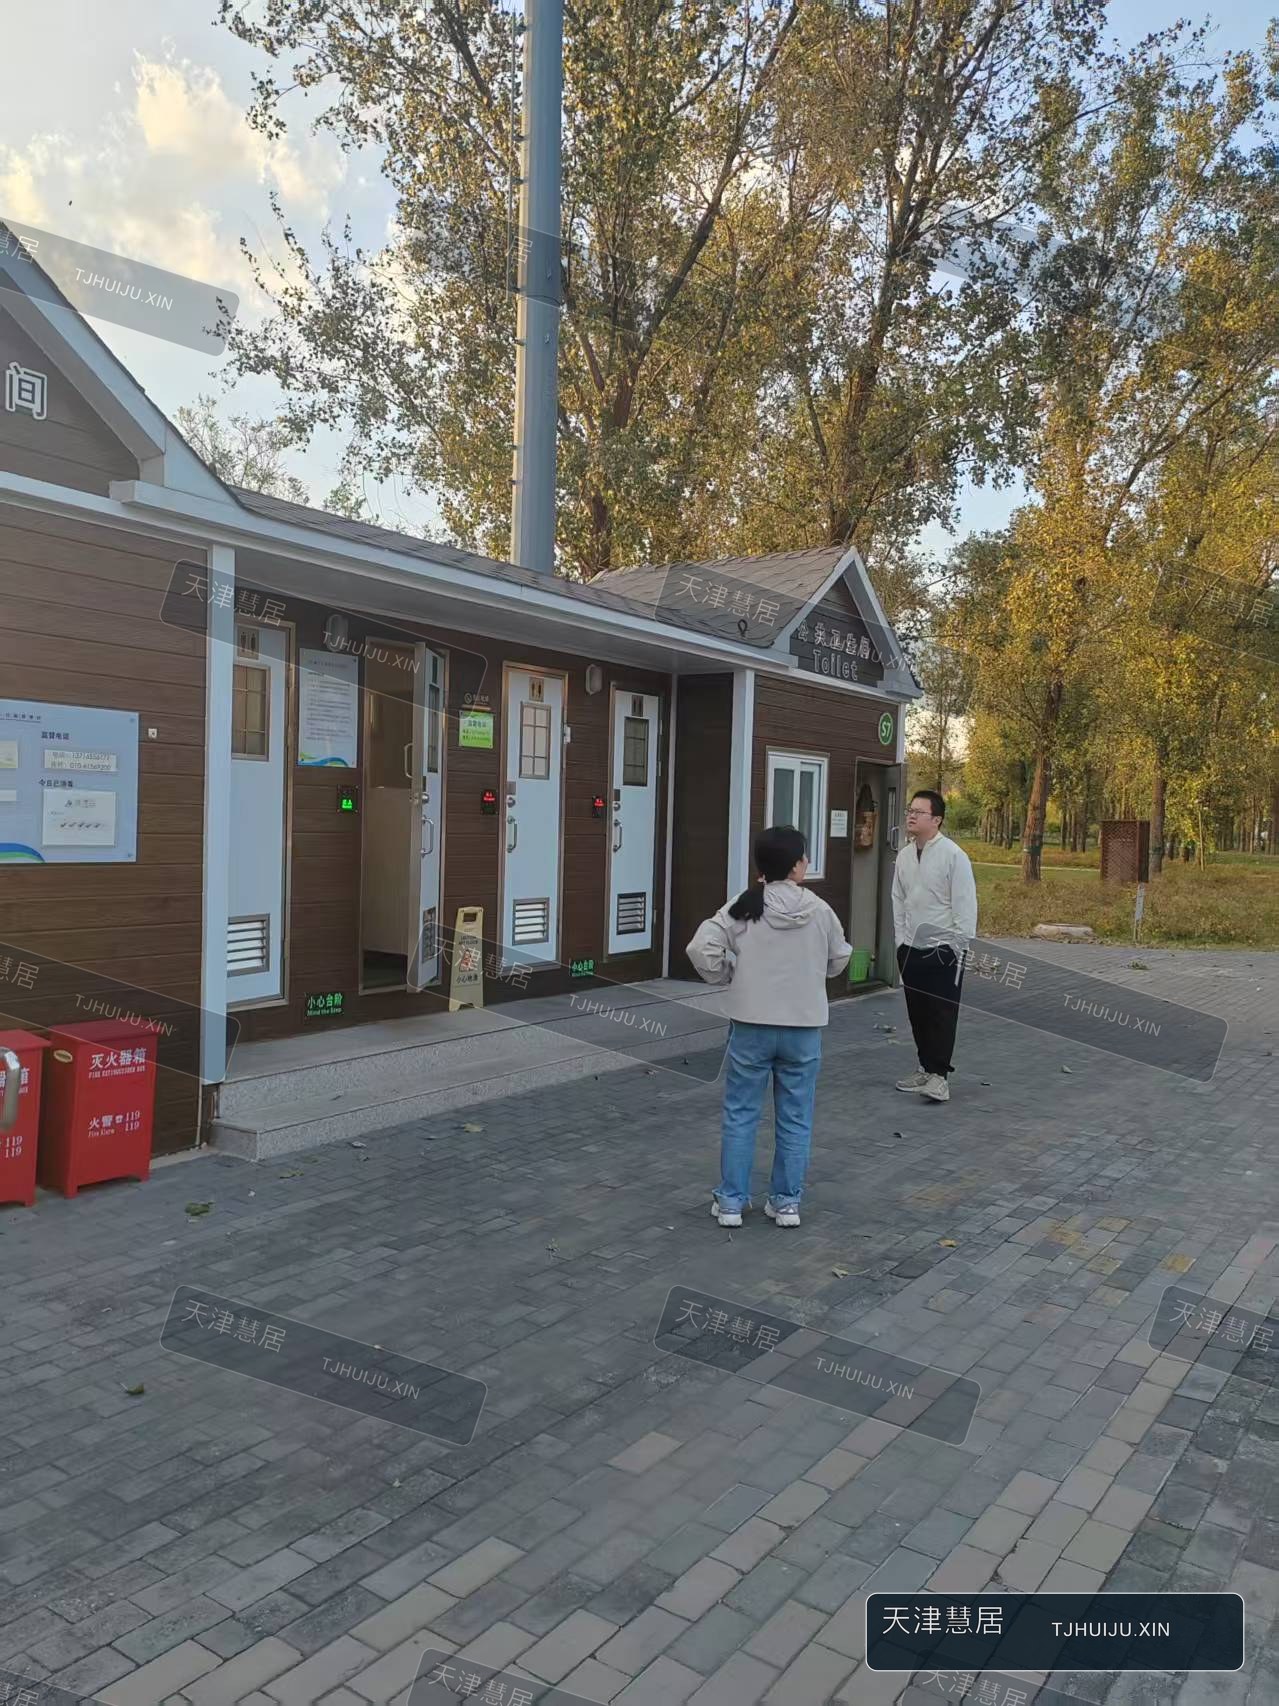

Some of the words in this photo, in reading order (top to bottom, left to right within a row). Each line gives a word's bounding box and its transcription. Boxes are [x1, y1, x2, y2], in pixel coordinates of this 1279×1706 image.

[5, 362, 48, 421] 间
[813, 649, 858, 681] Toilet
[307, 992, 343, 1009] 小心台阶
[89, 1047, 147, 1071] 灭火器箱
[88, 1114, 113, 1130] 火警
[125, 1111, 140, 1122] 119
[125, 1121, 140, 1132] 119
[5, 1136, 22, 1147] 119
[4, 1147, 22, 1158] 119
